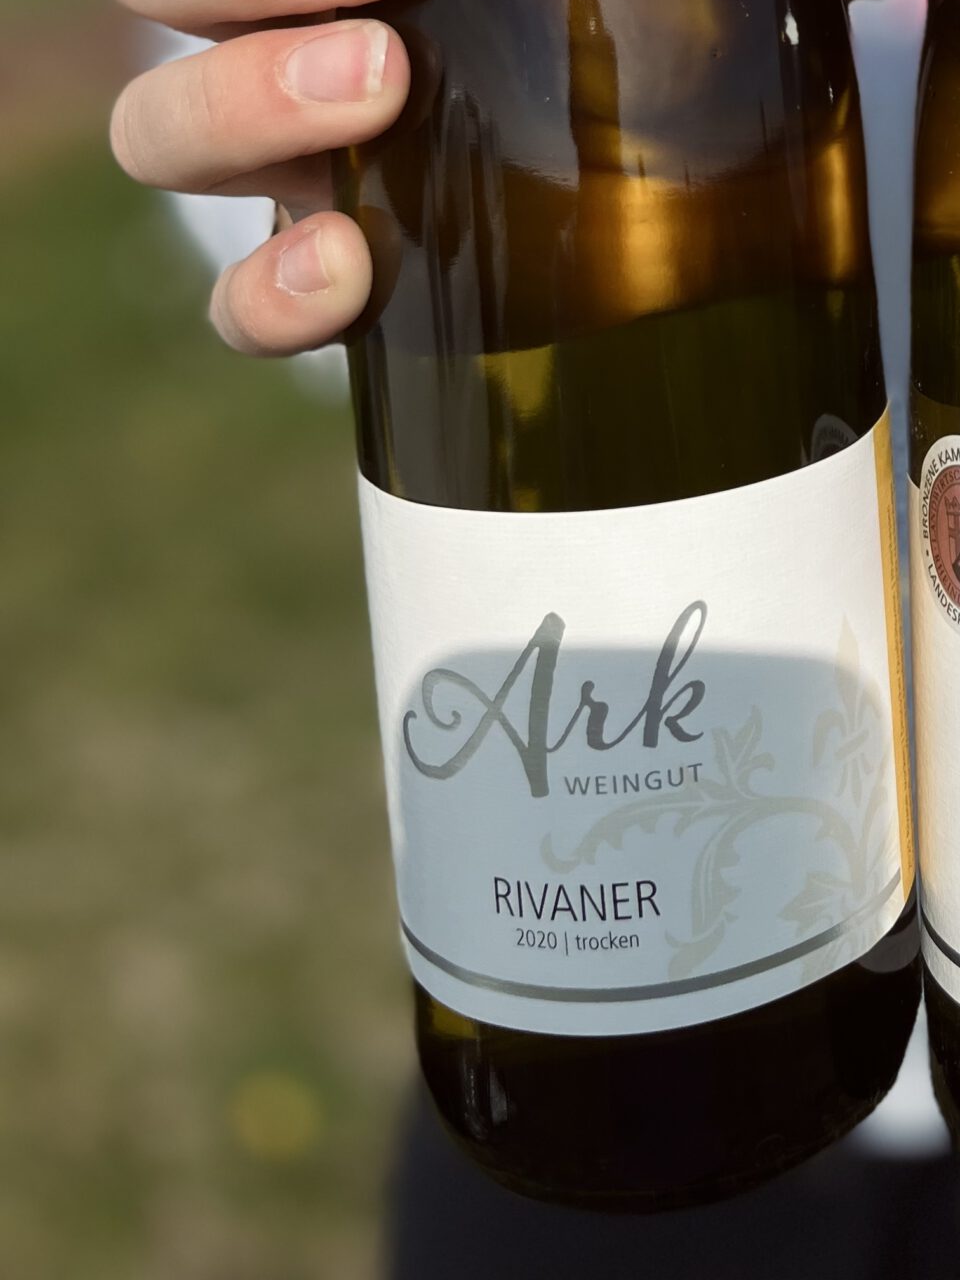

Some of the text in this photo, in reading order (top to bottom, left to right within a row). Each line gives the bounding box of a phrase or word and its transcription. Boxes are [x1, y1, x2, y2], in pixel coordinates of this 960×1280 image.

[921, 460, 939, 540] BRONZENE
[401, 599, 709, 799] Ark
[563, 762, 704, 797] WEINGUT
[493, 875, 662, 923] RIVANER
[515, 928, 558, 951] 2020
[574, 930, 641, 951] trocken
